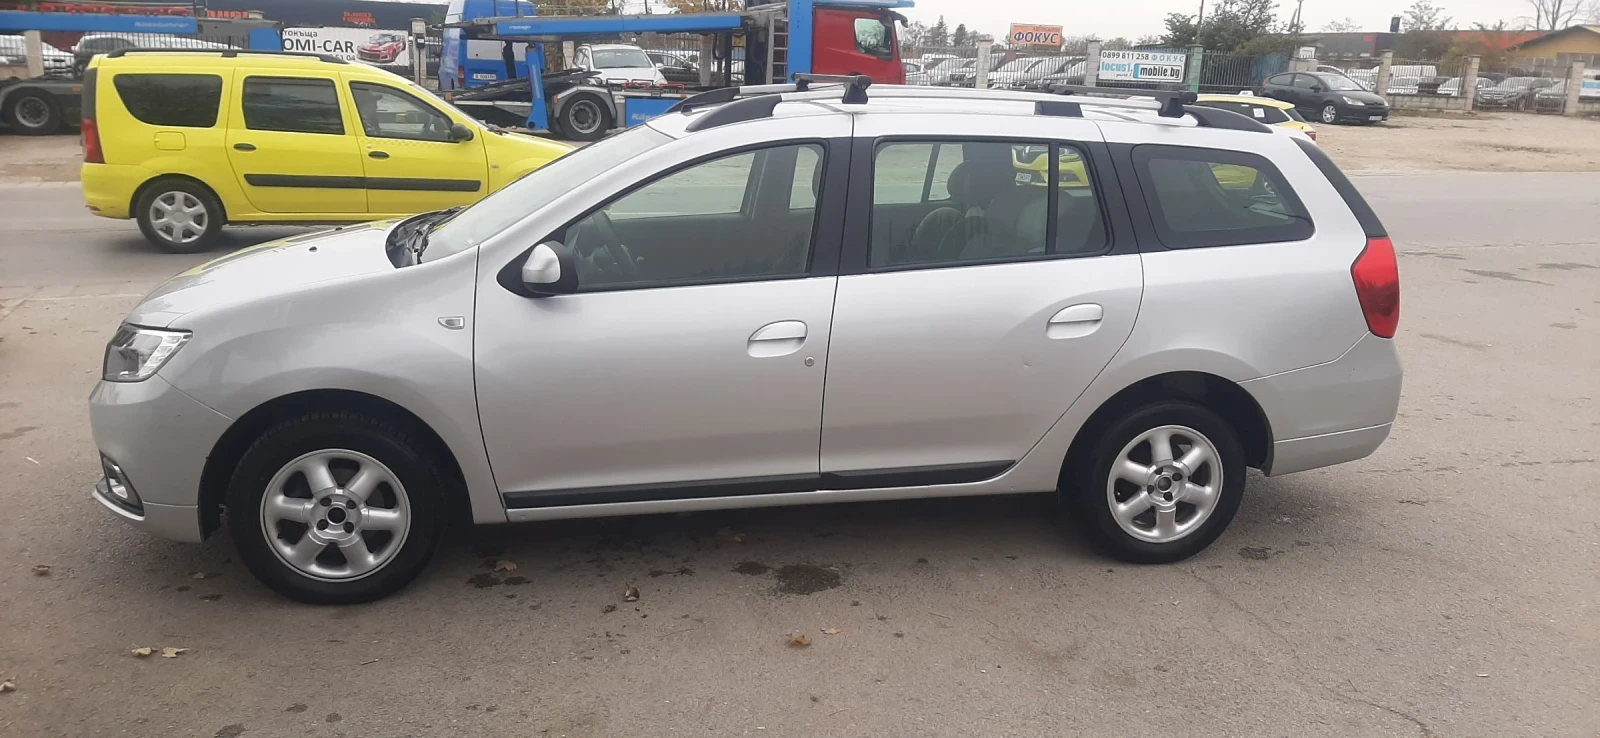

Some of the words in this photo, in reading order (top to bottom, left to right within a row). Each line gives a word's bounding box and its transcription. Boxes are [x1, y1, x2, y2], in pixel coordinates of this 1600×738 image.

[1014, 31, 1058, 43] ФОКУС
[1102, 51, 1120, 59] 0899
[1151, 54, 1185, 62] ФОКУС
[1140, 65, 1180, 78] mobile.bg
